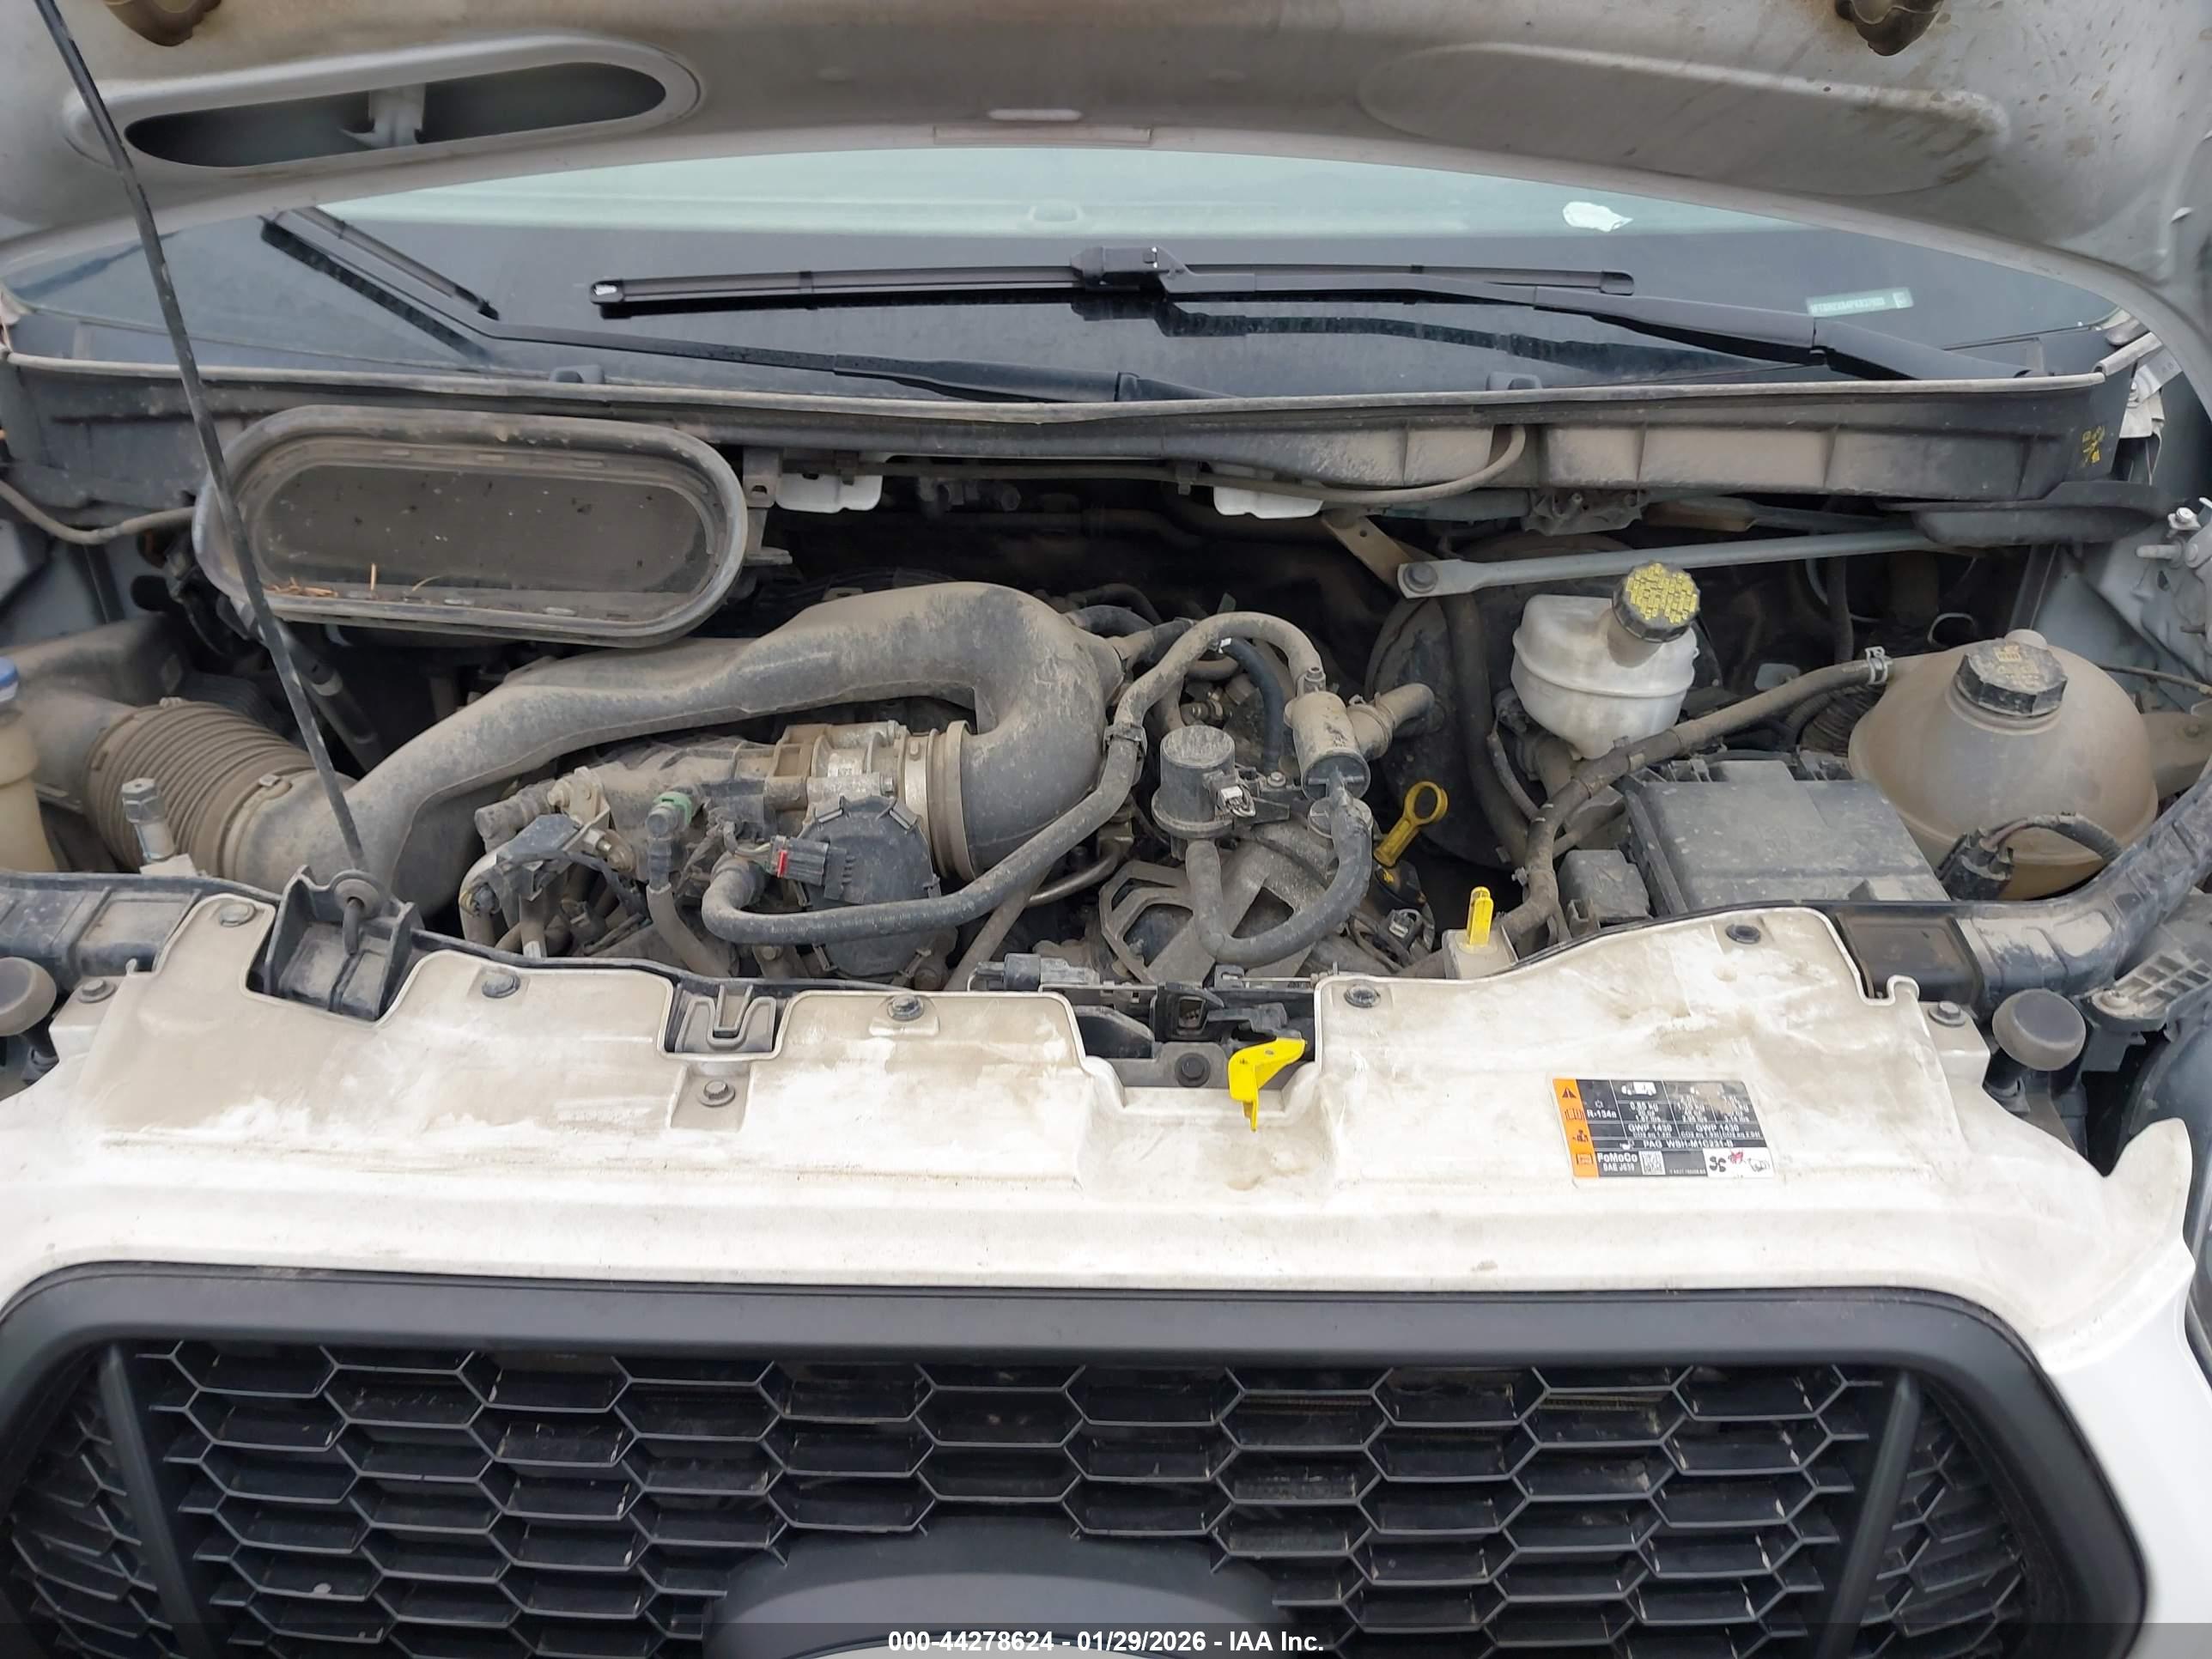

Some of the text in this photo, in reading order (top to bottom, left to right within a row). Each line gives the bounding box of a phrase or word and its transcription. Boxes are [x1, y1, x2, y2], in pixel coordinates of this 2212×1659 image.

[1586, 1109, 1617, 1118] R-134a
[1628, 1123, 1650, 1133] GWP
[1696, 1123, 1717, 1132] GWP
[1643, 1139, 1662, 1148] PAG
[1597, 1152, 1638, 1163] FoMoCo
